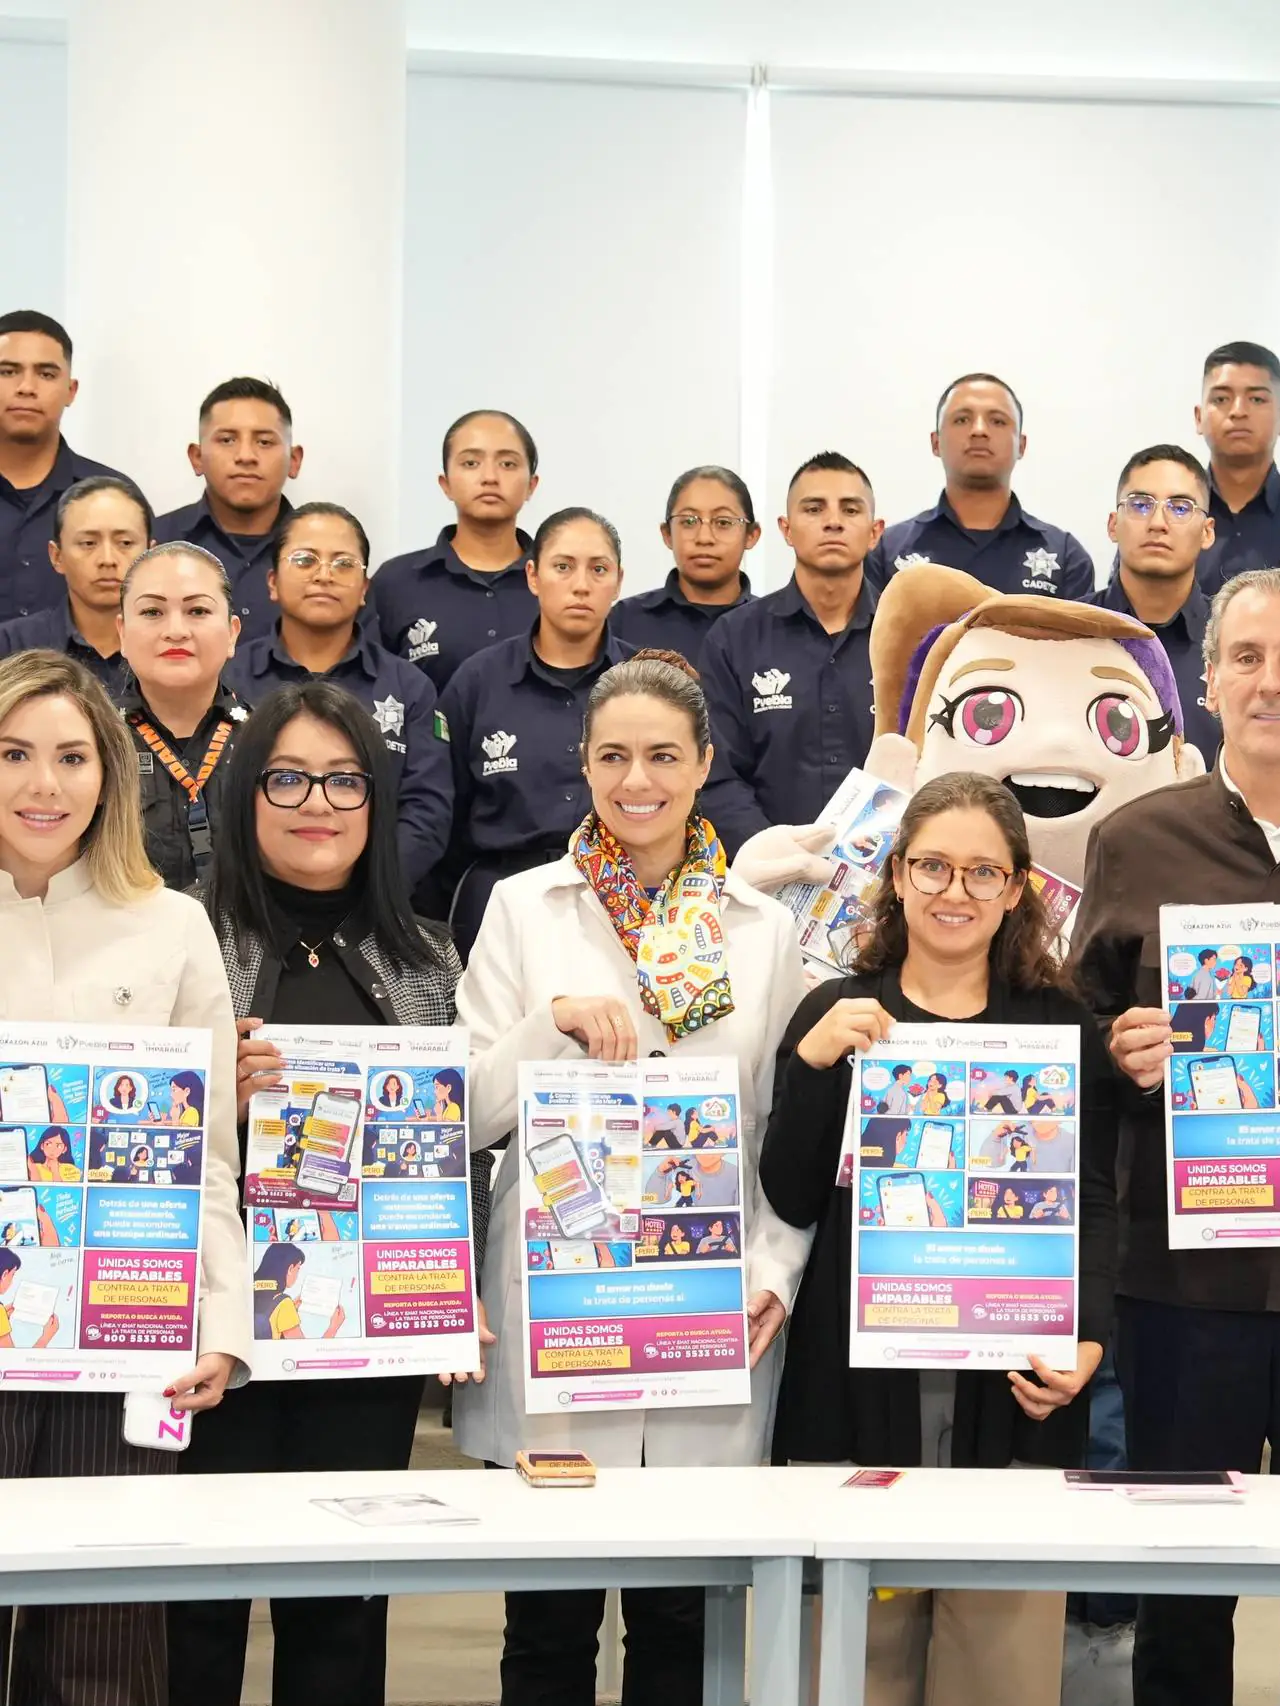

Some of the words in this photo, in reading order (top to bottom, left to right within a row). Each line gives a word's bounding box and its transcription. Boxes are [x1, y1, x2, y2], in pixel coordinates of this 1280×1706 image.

[1022, 579, 1057, 594] CADETE
[1227, 1137, 1235, 1145] la
[1237, 1136, 1260, 1146] trata
[1261, 1135, 1274, 1145] de
[1187, 1165, 1227, 1175] UNIDAS
[1229, 1163, 1267, 1173] SOMOS
[1188, 1175, 1267, 1186] IMPARABLES
[978, 1184, 997, 1193] HOTEL
[1189, 1188, 1225, 1196] CONTRA
[159, 1200, 187, 1210] oferta
[1209, 1198, 1256, 1206] PERSONAS
[645, 1219, 664, 1228] HOTEL
[377, 1249, 417, 1260] UNIDAS
[419, 1248, 457, 1258] SOMOS
[98, 1257, 140, 1268] UNIDAS
[143, 1259, 183, 1269] SOMOS
[377, 1259, 457, 1271] IMPARABLES
[98, 1270, 182, 1281] IMPARABLES
[378, 1273, 415, 1282] CONTRA
[416, 1273, 428, 1281] LA
[429, 1272, 458, 1281] TRATA
[97, 1283, 136, 1292] CONTRA
[138, 1284, 150, 1293] LA
[151, 1285, 180, 1293] TRATA
[384, 1284, 398, 1293] DE
[399, 1283, 446, 1292] PERSONAS
[872, 1282, 912, 1292] UNIDAS
[914, 1283, 952, 1293] SOMOS
[103, 1295, 117, 1303] DE
[119, 1295, 168, 1304] PERSONAS
[583, 1297, 591, 1305] la
[593, 1296, 617, 1305] trata
[619, 1295, 631, 1304] de
[633, 1295, 674, 1305] personas
[872, 1294, 952, 1304] IMPARABLES
[872, 1306, 910, 1314] CONTRA
[894, 1317, 940, 1325] PERSONAS
[1043, 1314, 1064, 1322] 000
[388, 1321, 410, 1329] 800
[414, 1320, 439, 1328] 5533
[443, 1318, 465, 1327] 000
[543, 1326, 583, 1336] UNIDAS
[585, 1324, 623, 1334] SOMOS
[104, 1335, 125, 1343] 800
[130, 1335, 156, 1343] 5533
[161, 1335, 183, 1343] 000
[544, 1335, 624, 1348] IMPARABLES
[545, 1350, 581, 1359] CONTRA
[582, 1349, 593, 1357] LA
[595, 1348, 624, 1356] TRATA
[661, 1351, 681, 1359] 800
[685, 1350, 710, 1358] 5533
[551, 1360, 564, 1369] DE
[565, 1359, 612, 1369] PERSONAS
